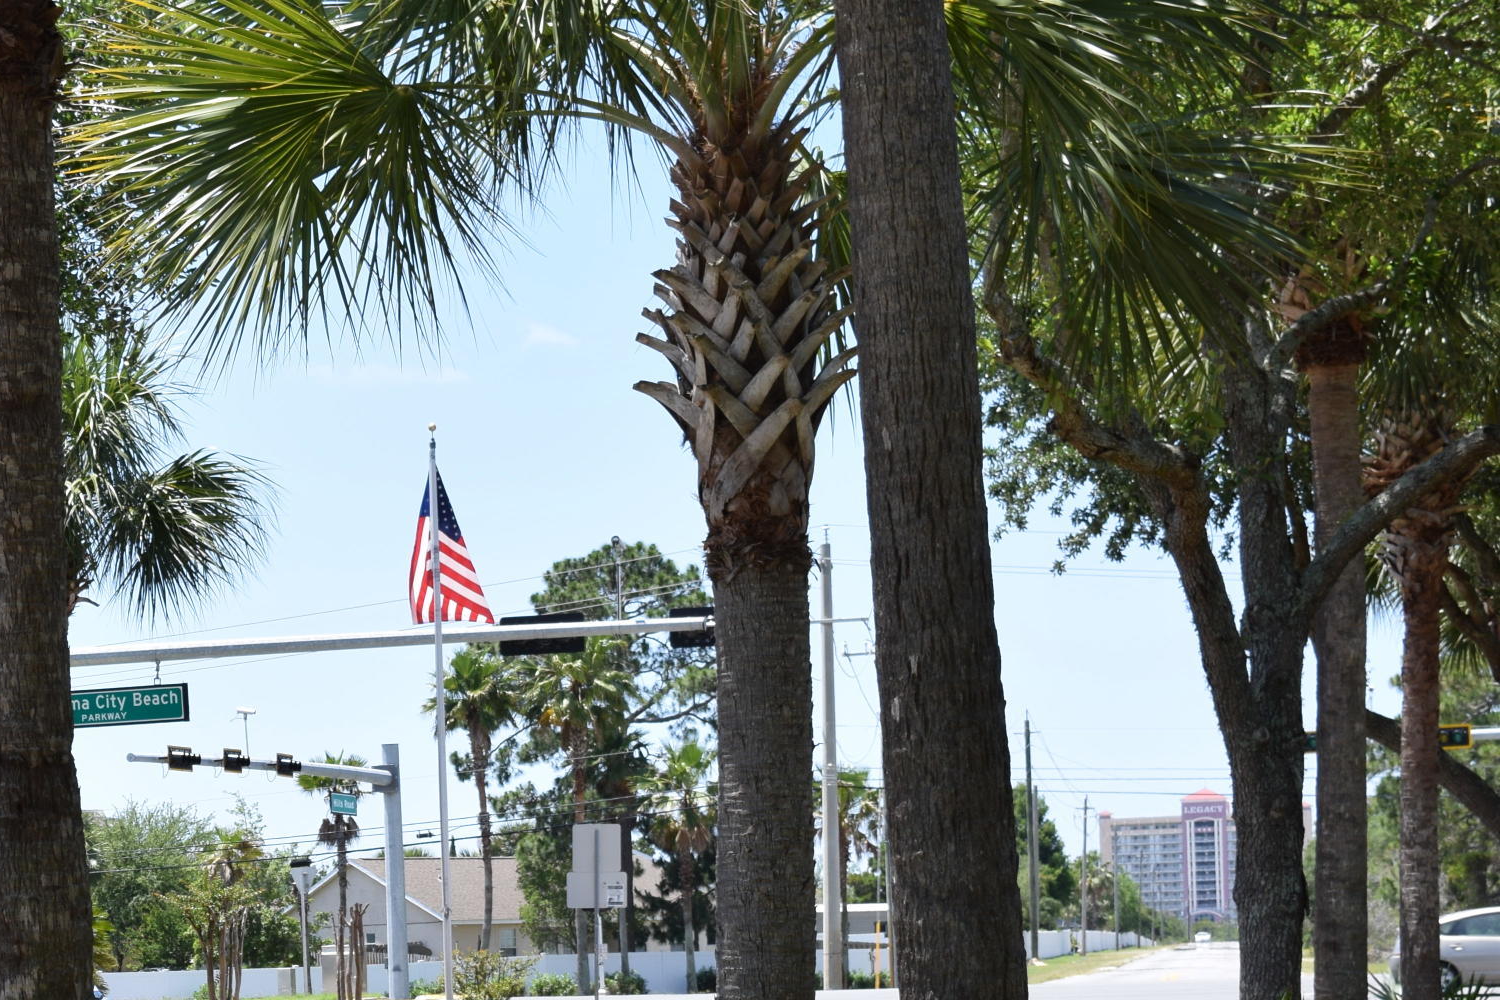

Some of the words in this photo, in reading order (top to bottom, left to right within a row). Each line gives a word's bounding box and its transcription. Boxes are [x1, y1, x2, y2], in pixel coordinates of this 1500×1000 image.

[95, 694, 126, 710] City
[132, 690, 178, 706] Beach
[81, 711, 127, 722] PARKWAY
[1184, 805, 1223, 814] LEGACY
